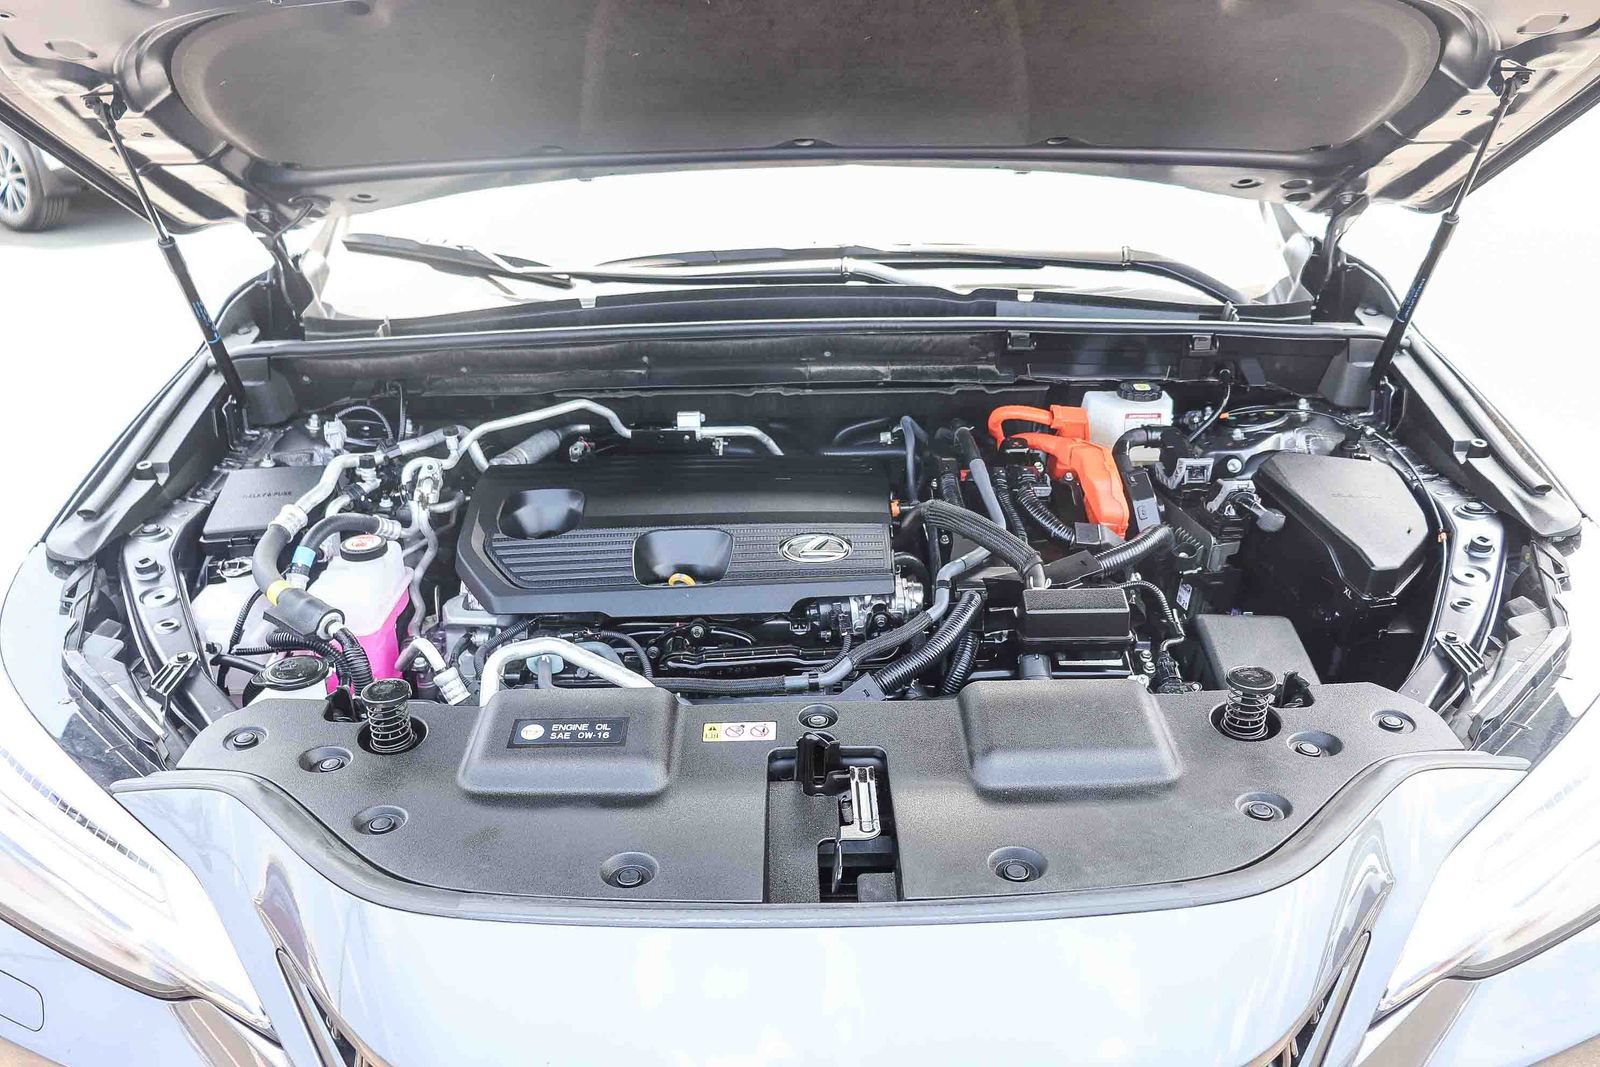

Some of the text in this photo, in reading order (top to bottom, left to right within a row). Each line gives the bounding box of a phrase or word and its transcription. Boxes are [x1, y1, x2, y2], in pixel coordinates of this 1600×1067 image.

[551, 723, 611, 731] ENGINE OIL
[577, 731, 610, 739] 0W-16
